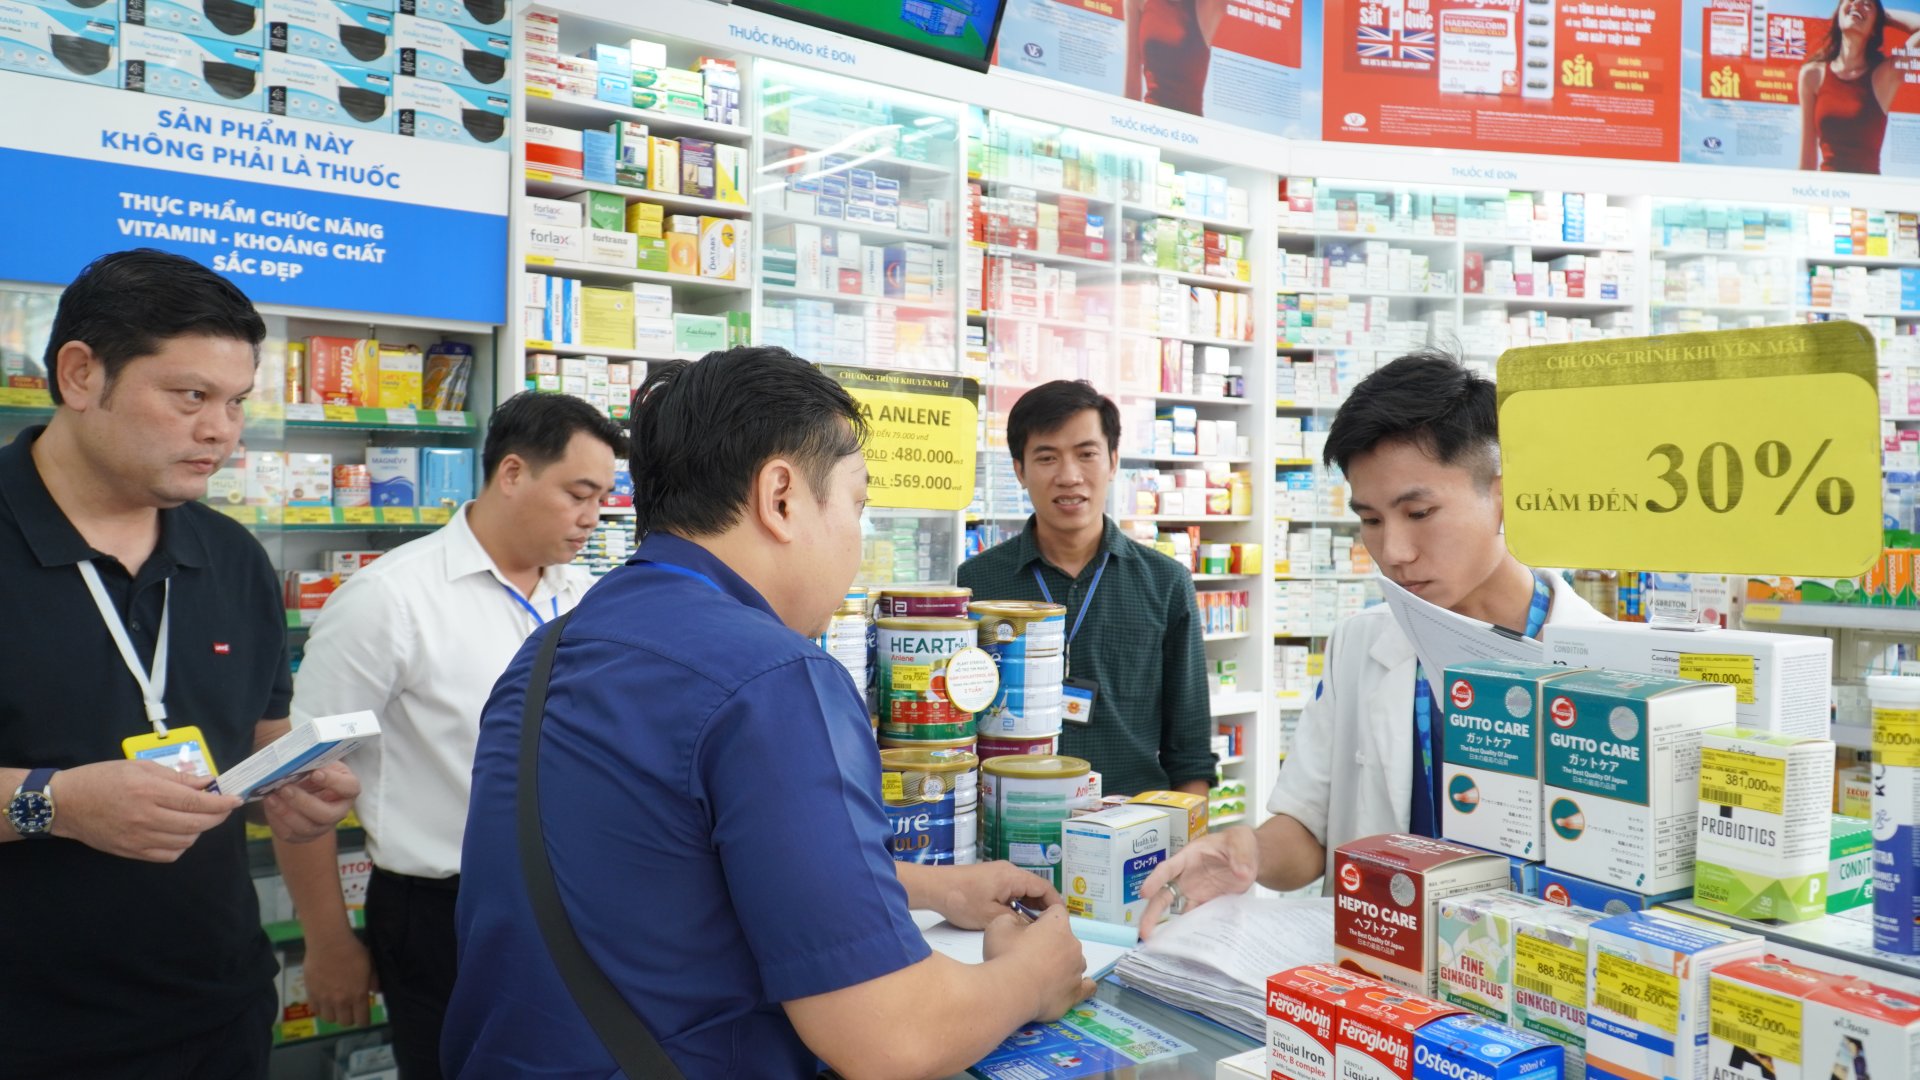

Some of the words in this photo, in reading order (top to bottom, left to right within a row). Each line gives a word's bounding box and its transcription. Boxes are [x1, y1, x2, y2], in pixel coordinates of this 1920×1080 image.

[728, 25, 769, 45] THUỐC
[771, 35, 814, 55] KHÔNG
[1561, 54, 1594, 88] Sắt
[1710, 64, 1741, 99] Sắt
[158, 106, 212, 134] SẢN
[221, 119, 297, 148] PHẨM
[305, 132, 354, 155] NÀY
[101, 130, 204, 161] KHÔNG
[213, 146, 273, 171] PHẢI
[282, 155, 310, 176] LÀ
[317, 162, 401, 189] THUỐC
[119, 192, 184, 218] THỰC
[190, 200, 256, 224] PHẨM
[261, 208, 321, 232] CHỨC
[324, 217, 384, 239] NĂNG
[534, 203, 562, 216] forlax
[118, 218, 217, 245] VITAMIN
[234, 231, 328, 258] KHOÁNG
[334, 242, 386, 264] CHẤT
[530, 230, 569, 246] forlax
[592, 232, 629, 246] fortrans
[212, 251, 257, 275] SẮC
[260, 260, 303, 282] ĐẸP
[878, 405, 952, 427] ANLENE
[892, 432, 916, 440] 79.000
[1515, 488, 1580, 512] GIẢM
[1587, 488, 1639, 512] ĐẾN
[1645, 438, 1856, 516] 30%
[890, 636, 957, 654] HEART
[1554, 645, 1589, 656] CONDITION
[1450, 714, 1492, 732] GUTTO
[1494, 720, 1530, 738] CARE
[1466, 732, 1512, 749] ガットケア
[1550, 732, 1598, 753] GUTTO
[1600, 742, 1640, 762] CARE
[1480, 748, 1499, 758] Quality
[1569, 754, 1620, 773] ガットケア
[1562, 766, 1573, 774] The
[1572, 768, 1585, 777] Best
[1584, 770, 1605, 782] Quality
[1611, 776, 1629, 785] Japan
[1701, 816, 1777, 847] PROBIOTICS
[1698, 883, 1720, 893] MADE
[1722, 888, 1729, 896] IN
[1698, 890, 1729, 903] GERMANY
[1338, 894, 1379, 919] HEPTO
[1381, 908, 1417, 931] CARE
[1354, 918, 1398, 938] ヘプトケア
[1358, 930, 1368, 938] Best
[1368, 932, 1385, 945] Quality
[1390, 940, 1405, 952] Japan
[1461, 955, 1485, 977] FINE
[1440, 966, 1477, 990] GINKGO
[1480, 980, 1504, 1000] PLUS
[1268, 991, 1331, 1030] Feroglobin
[1516, 990, 1557, 1016] GINKGO
[1560, 1006, 1586, 1026] PLUS
[1317, 1027, 1330, 1040] B12
[1340, 1018, 1409, 1061] Feroglobin
[1272, 1036, 1300, 1056] Liquid
[1302, 1045, 1326, 1067] Iron
[1272, 1048, 1288, 1063] Zinc,
[1289, 1056, 1295, 1065] B
[1296, 1060, 1327, 1079] complex
[1394, 1058, 1408, 1071] B12
